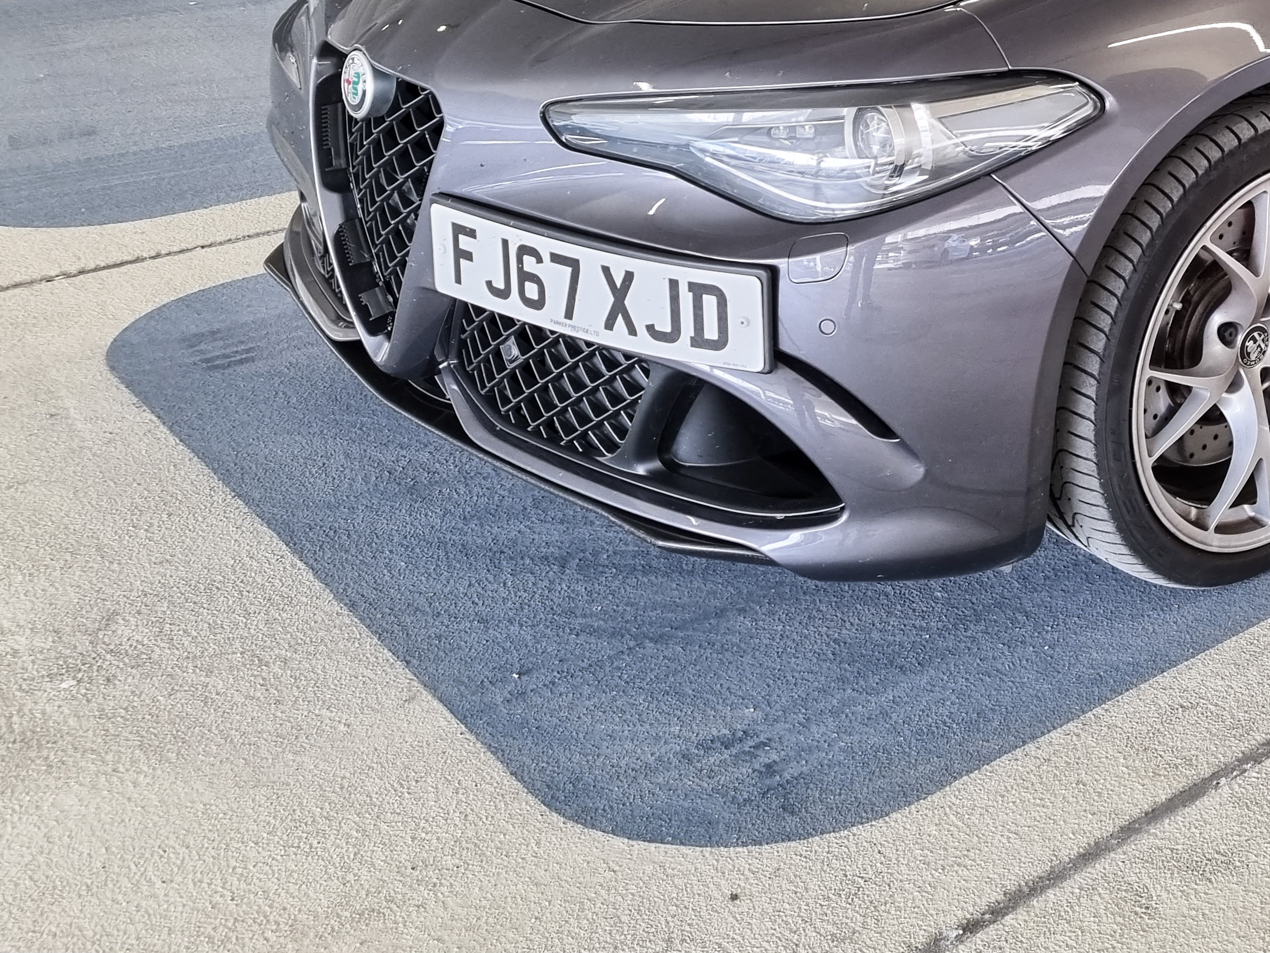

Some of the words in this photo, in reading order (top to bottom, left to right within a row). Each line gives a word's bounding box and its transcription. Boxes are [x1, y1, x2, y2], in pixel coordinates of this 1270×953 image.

[451, 221, 581, 321] FJ67
[601, 264, 730, 352] XJD
[550, 318, 568, 328] PARKER
